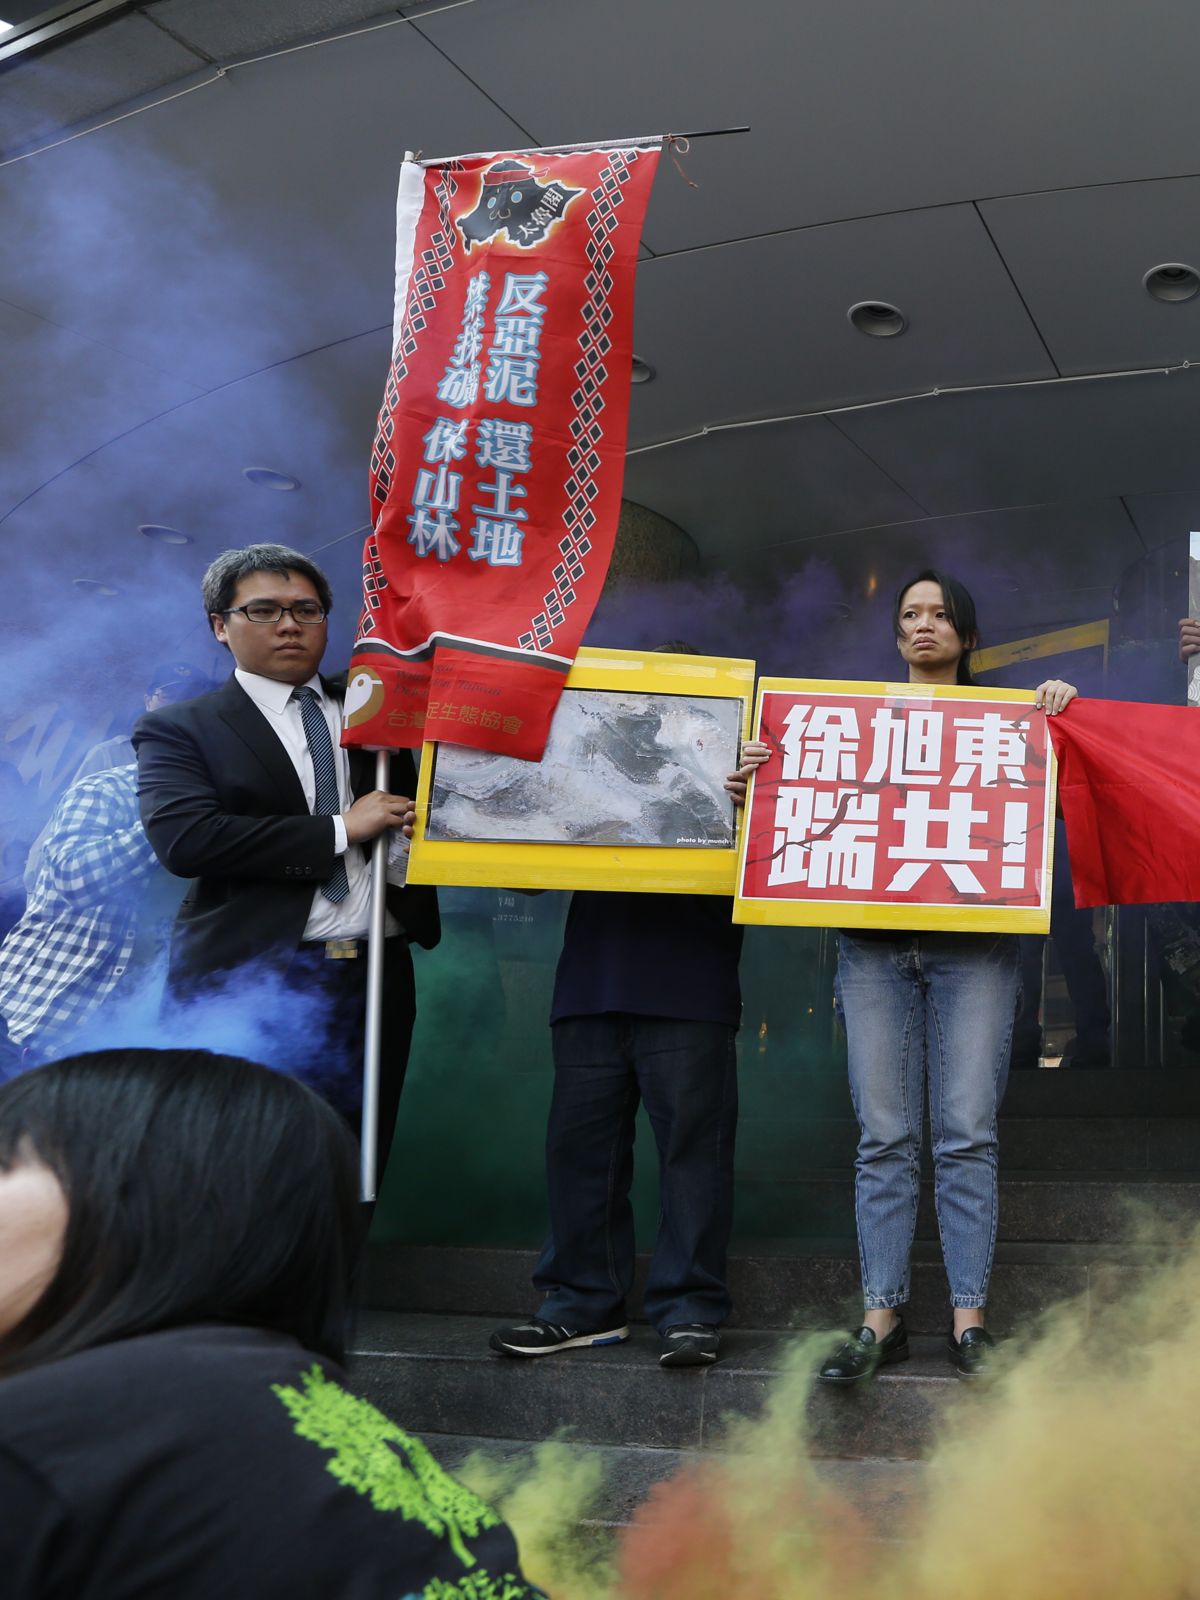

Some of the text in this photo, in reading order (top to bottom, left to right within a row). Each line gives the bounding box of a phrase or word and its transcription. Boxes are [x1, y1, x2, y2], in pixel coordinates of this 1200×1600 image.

[517, 187, 563, 240] 太魯閣
[468, 271, 549, 566] 反亞泥 還土地
[406, 416, 468, 562] 保山林
[780, 703, 1030, 789] 徐旭東
[767, 786, 1028, 894] 踹共!
